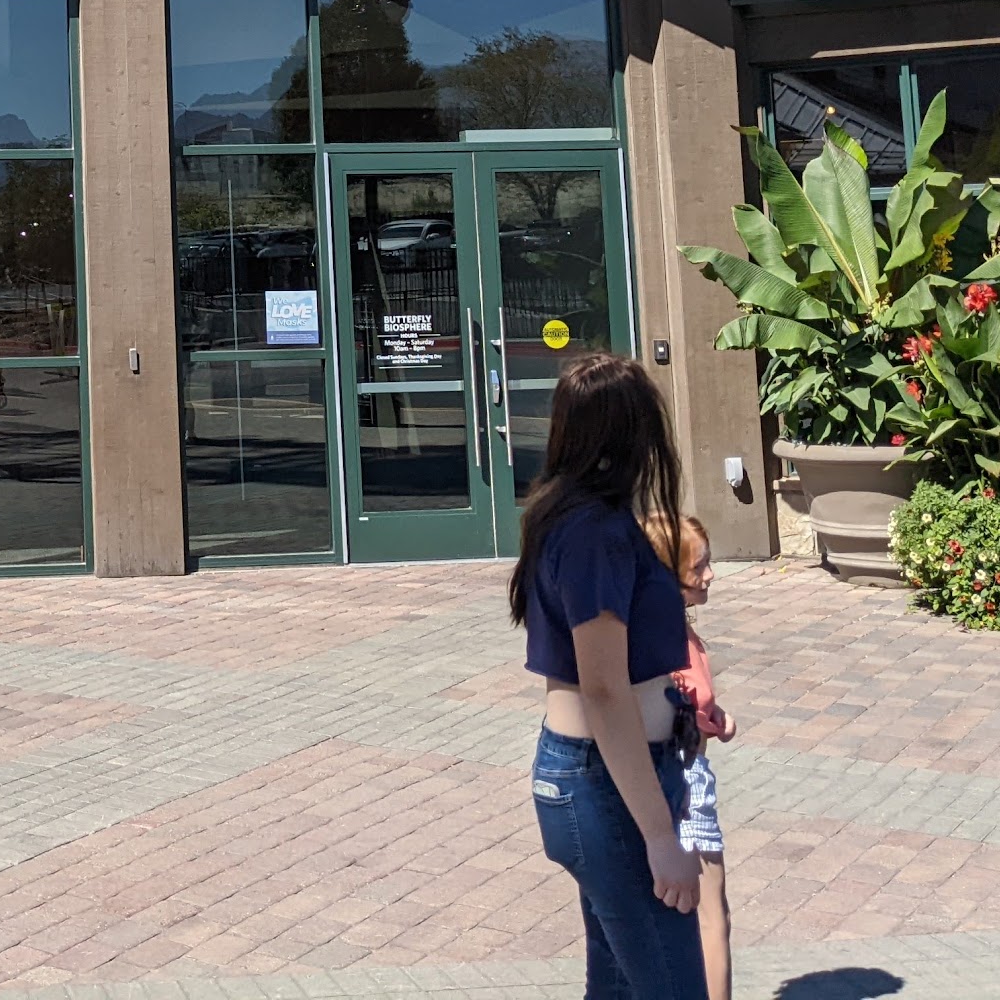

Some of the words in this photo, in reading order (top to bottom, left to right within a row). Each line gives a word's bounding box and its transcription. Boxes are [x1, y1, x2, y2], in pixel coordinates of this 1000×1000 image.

[272, 297, 288, 305] We
[271, 303, 312, 319] LOVE
[277, 318, 307, 326] Masks
[384, 315, 431, 323] BUTTERFLY
[384, 323, 432, 332] BIOSPHERE
